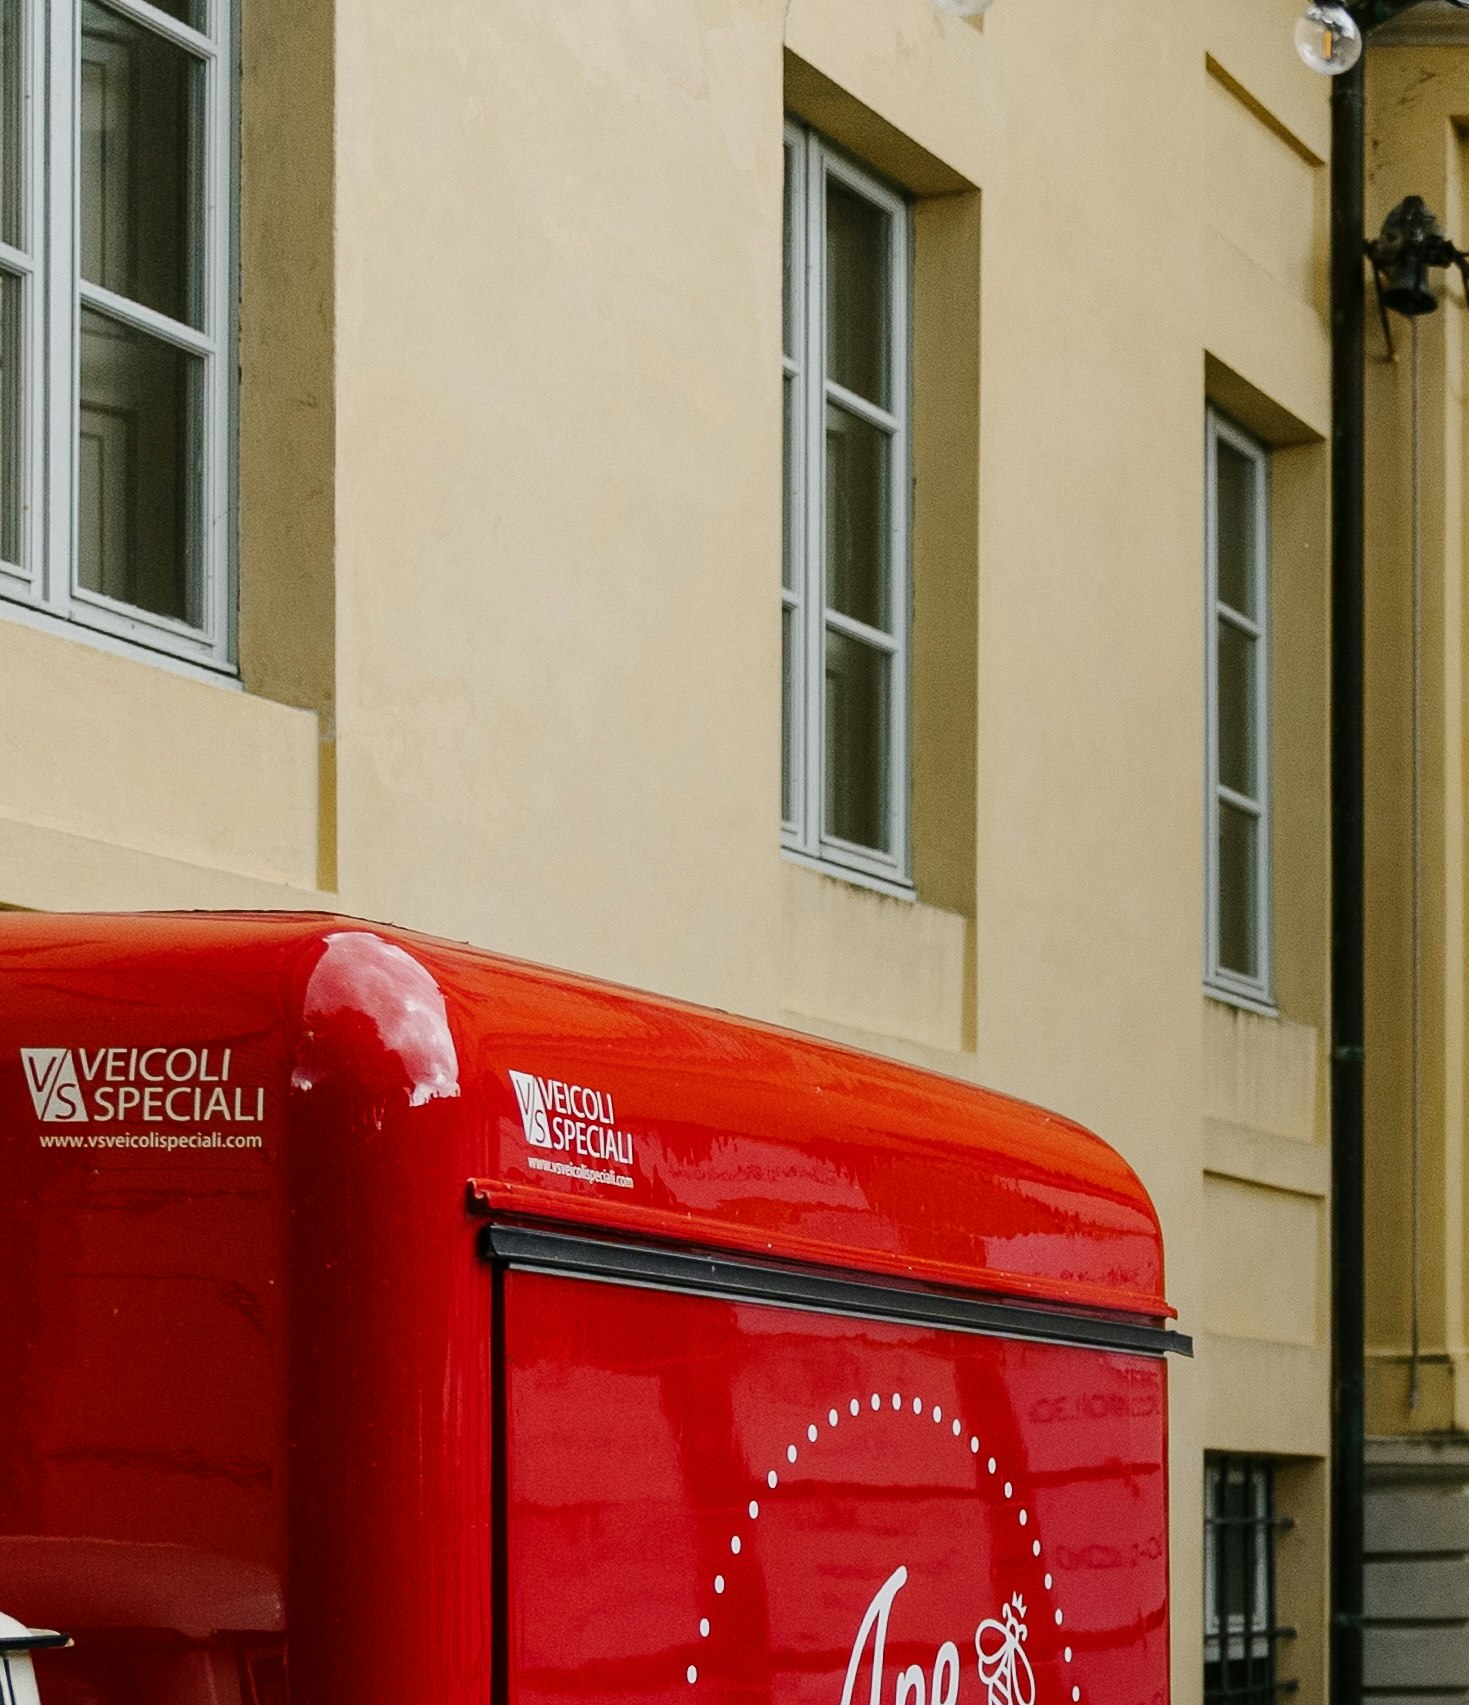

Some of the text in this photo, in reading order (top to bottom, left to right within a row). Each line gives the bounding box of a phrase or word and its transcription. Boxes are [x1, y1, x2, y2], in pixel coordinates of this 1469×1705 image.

[78, 1048, 231, 1081] VEICOLI
[93, 1087, 264, 1121] SPECIALI
[538, 1076, 615, 1125] VEICOLI
[39, 1132, 262, 1151] www.vsveicolispeciali.com
[552, 1116, 634, 1165] SPECIALI
